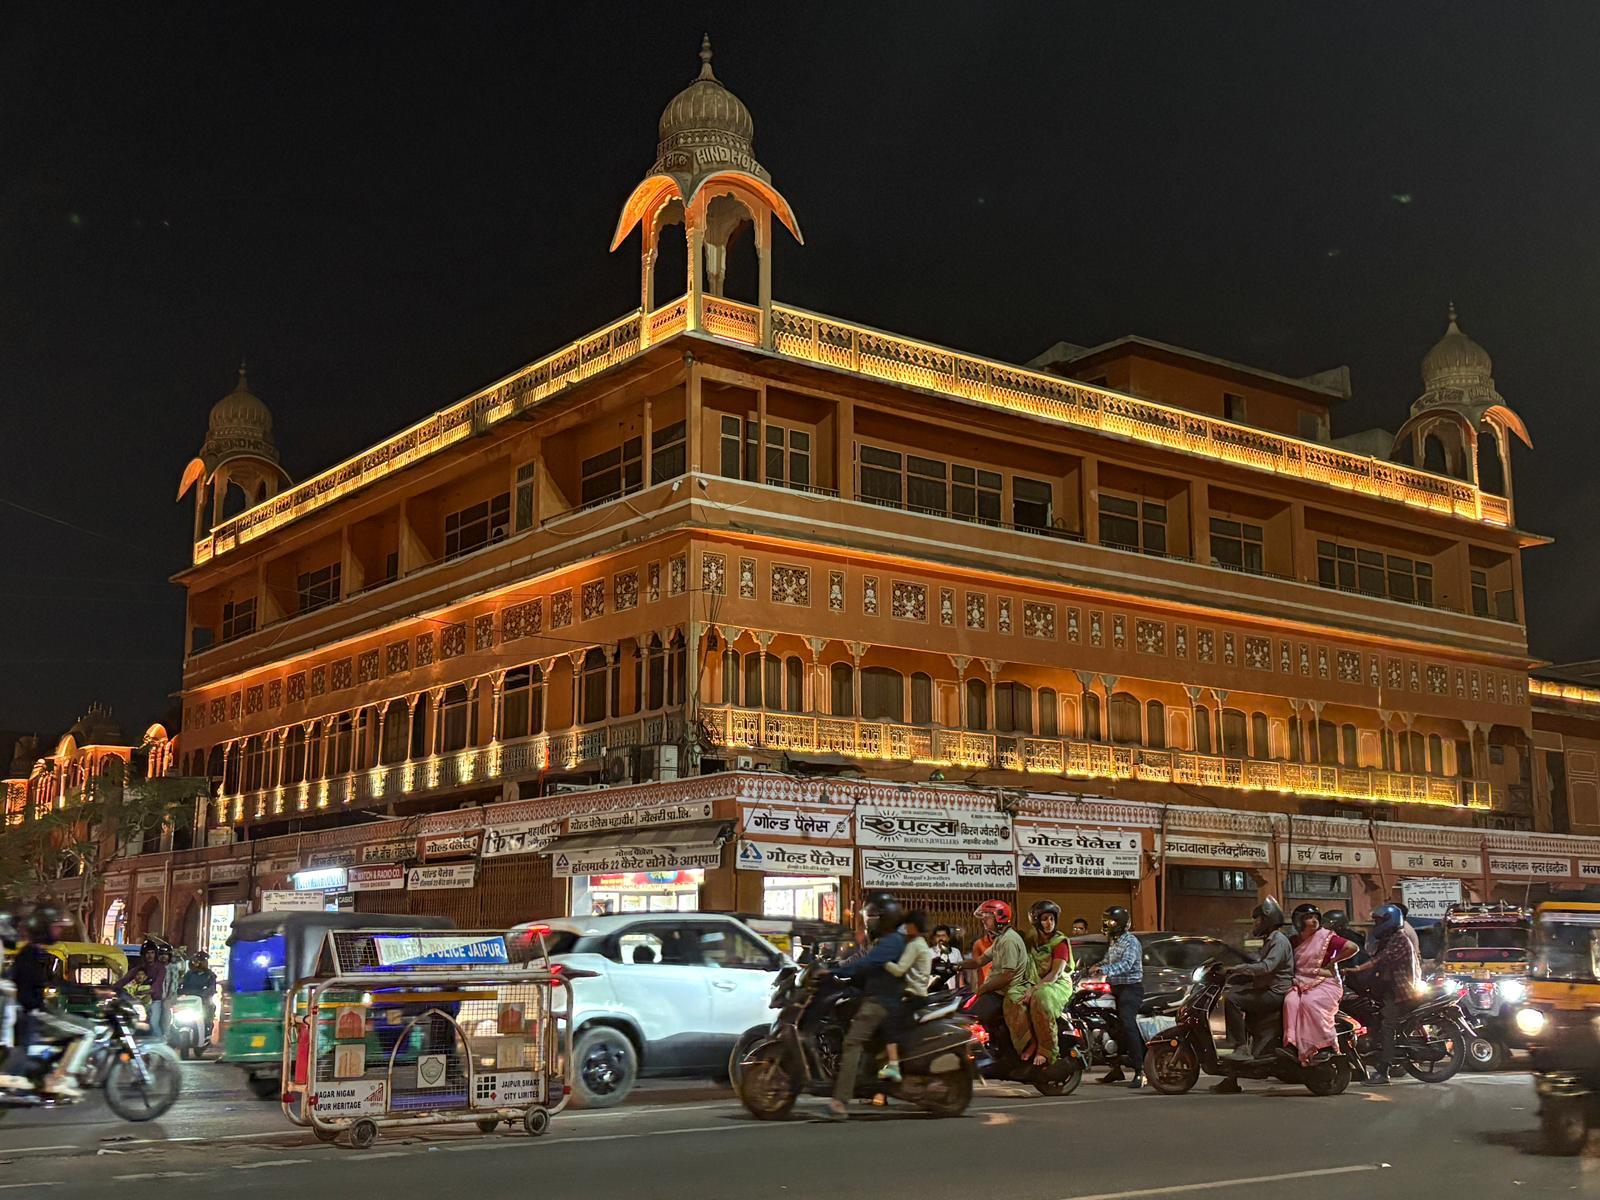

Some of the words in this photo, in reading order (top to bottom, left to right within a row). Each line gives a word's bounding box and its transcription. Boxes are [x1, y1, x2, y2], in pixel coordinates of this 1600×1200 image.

[753, 813, 790, 830] गोल्ड
[794, 815, 830, 832] पैलेस
[960, 823, 978, 836] किरन
[1027, 834, 1073, 847] गोल्ड
[1075, 836, 1121, 849] पैलेस
[766, 847, 807, 864] गोल्ड
[809, 850, 851, 867] पैलेस
[1045, 853, 1073, 865] गोल्ड
[1075, 854, 1105, 866] पैलेस
[1319, 850, 1343, 861] वर्धन
[1432, 857, 1453, 867] वर्धन
[572, 857, 609, 873] हॉलमार्क
[611, 859, 619, 870] 22
[646, 854, 666, 868] सोने
[667, 854, 678, 867] के
[431, 945, 466, 958] POLICE
[468, 943, 502, 958] JAIPUR
[502, 1080, 520, 1088] JAIPUR
[522, 1079, 539, 1087] SMART
[336, 1089, 355, 1097] NIGAM
[504, 1092, 516, 1100] CITY
[518, 1091, 539, 1099] LIMITED
[332, 1101, 361, 1110] HERITAGE
